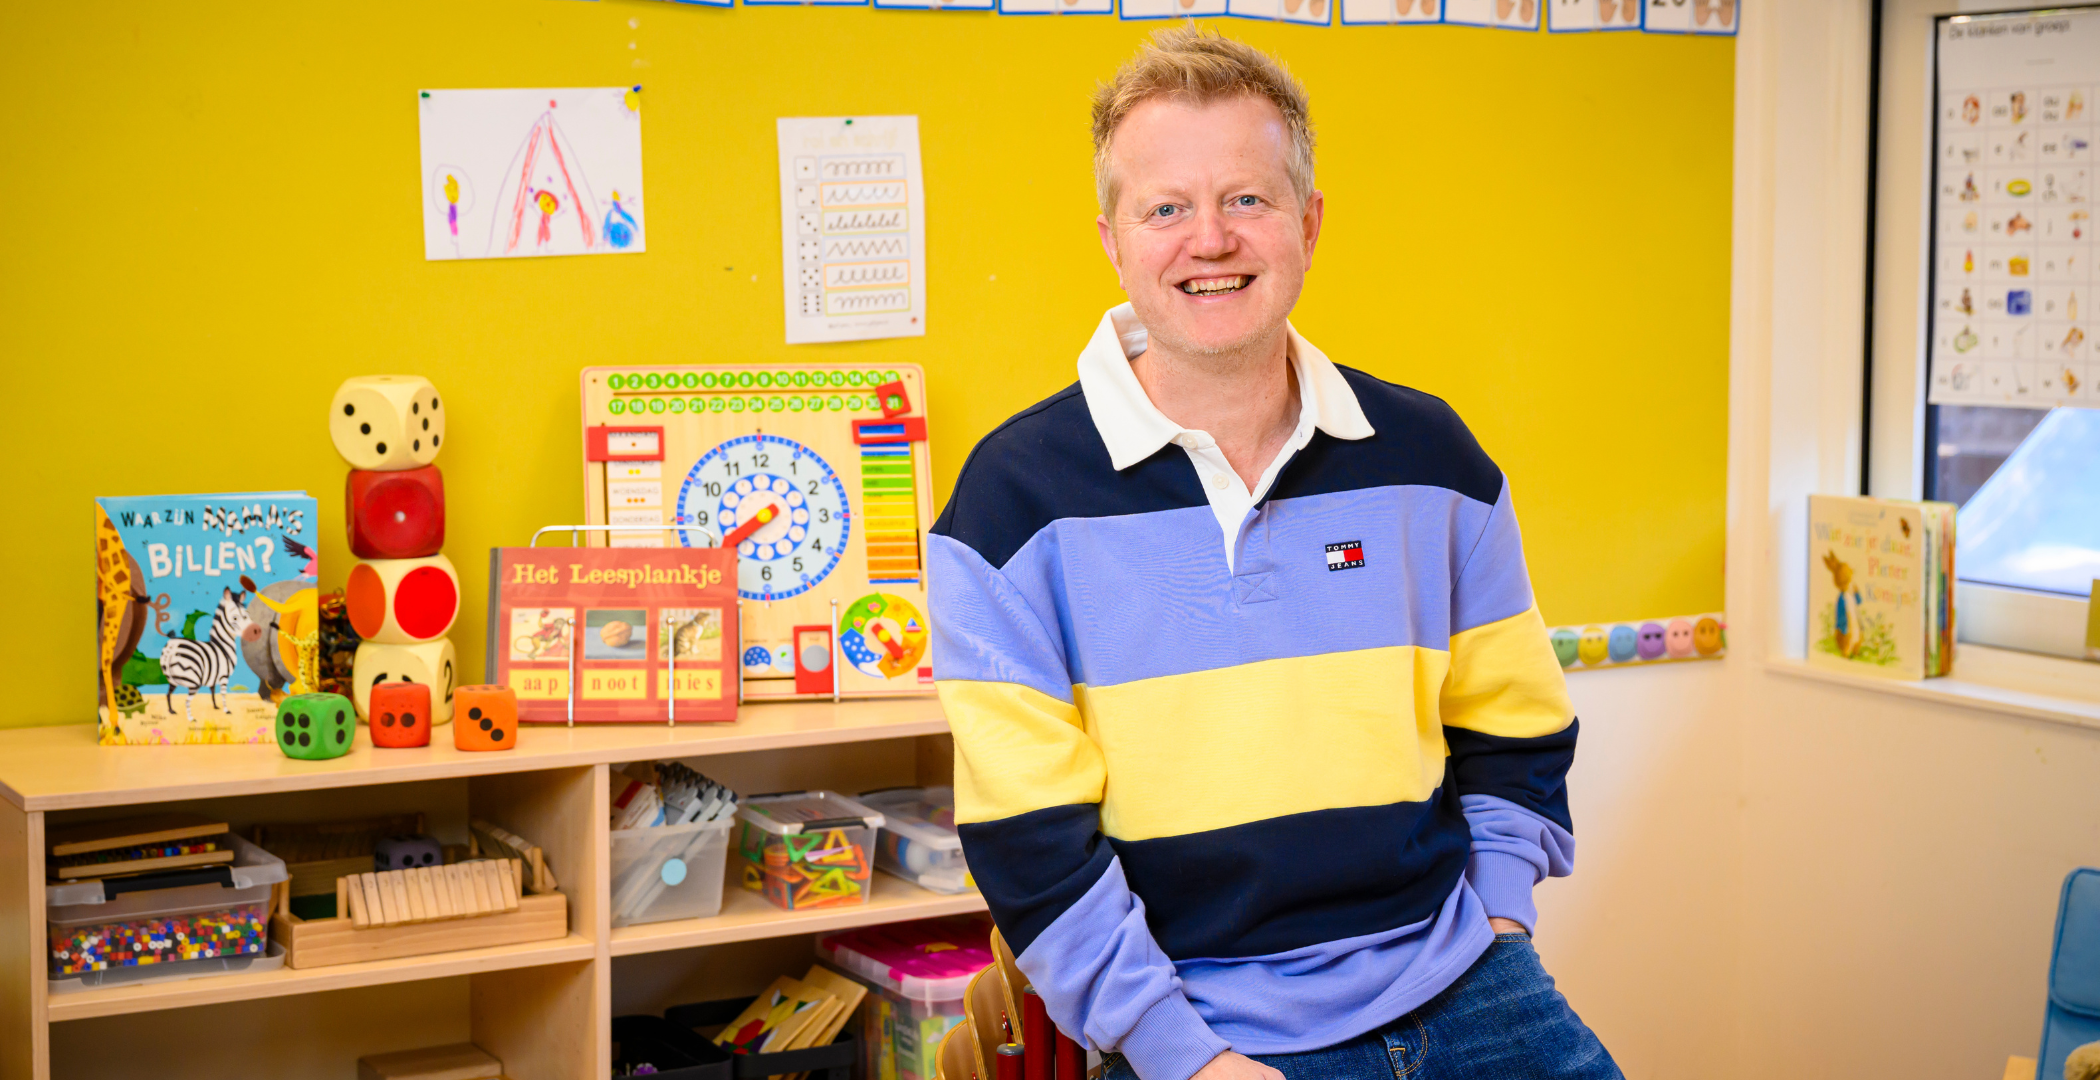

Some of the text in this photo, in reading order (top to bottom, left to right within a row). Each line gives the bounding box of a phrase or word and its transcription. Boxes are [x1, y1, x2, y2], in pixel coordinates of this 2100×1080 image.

[614, 377, 619, 388] 1
[631, 376, 638, 388] 2
[650, 376, 658, 387] 3
[668, 376, 675, 386] 4
[687, 375, 694, 386] 5
[705, 375, 713, 386] 6
[724, 375, 731, 386] 7
[742, 374, 750, 386] 8
[760, 374, 768, 386] 9
[776, 374, 788, 385] 10
[795, 374, 806, 384] 11
[813, 374, 825, 385] 12
[831, 374, 843, 384] 13
[849, 374, 861, 384] 14
[867, 374, 880, 384] 15
[611, 402, 624, 412] 17
[631, 401, 644, 412] 18
[651, 401, 664, 412] 19
[671, 401, 684, 412] 20
[691, 400, 704, 412] 21
[710, 400, 724, 412] 22
[730, 400, 744, 410] 23
[750, 399, 762, 410] 24
[770, 398, 784, 410] 25
[790, 398, 802, 410] 26
[810, 398, 822, 409] 27
[829, 398, 842, 408] 28
[849, 398, 862, 408] 29
[752, 453, 769, 468] 12
[790, 461, 797, 475] 1
[724, 462, 739, 476] 11
[702, 482, 721, 497] 10
[808, 480, 818, 495] 2
[121, 510, 162, 528] WAAR
[202, 503, 304, 538] MAMA'S
[698, 511, 708, 526] 9
[819, 508, 829, 523] 3
[812, 538, 822, 552] 4
[1327, 542, 1359, 551] TOMMY
[793, 557, 803, 572] 5
[1331, 560, 1363, 569] JEANS
[512, 563, 722, 590] Het Leesplankje
[762, 566, 772, 581] 6
[444, 659, 453, 704] 2
